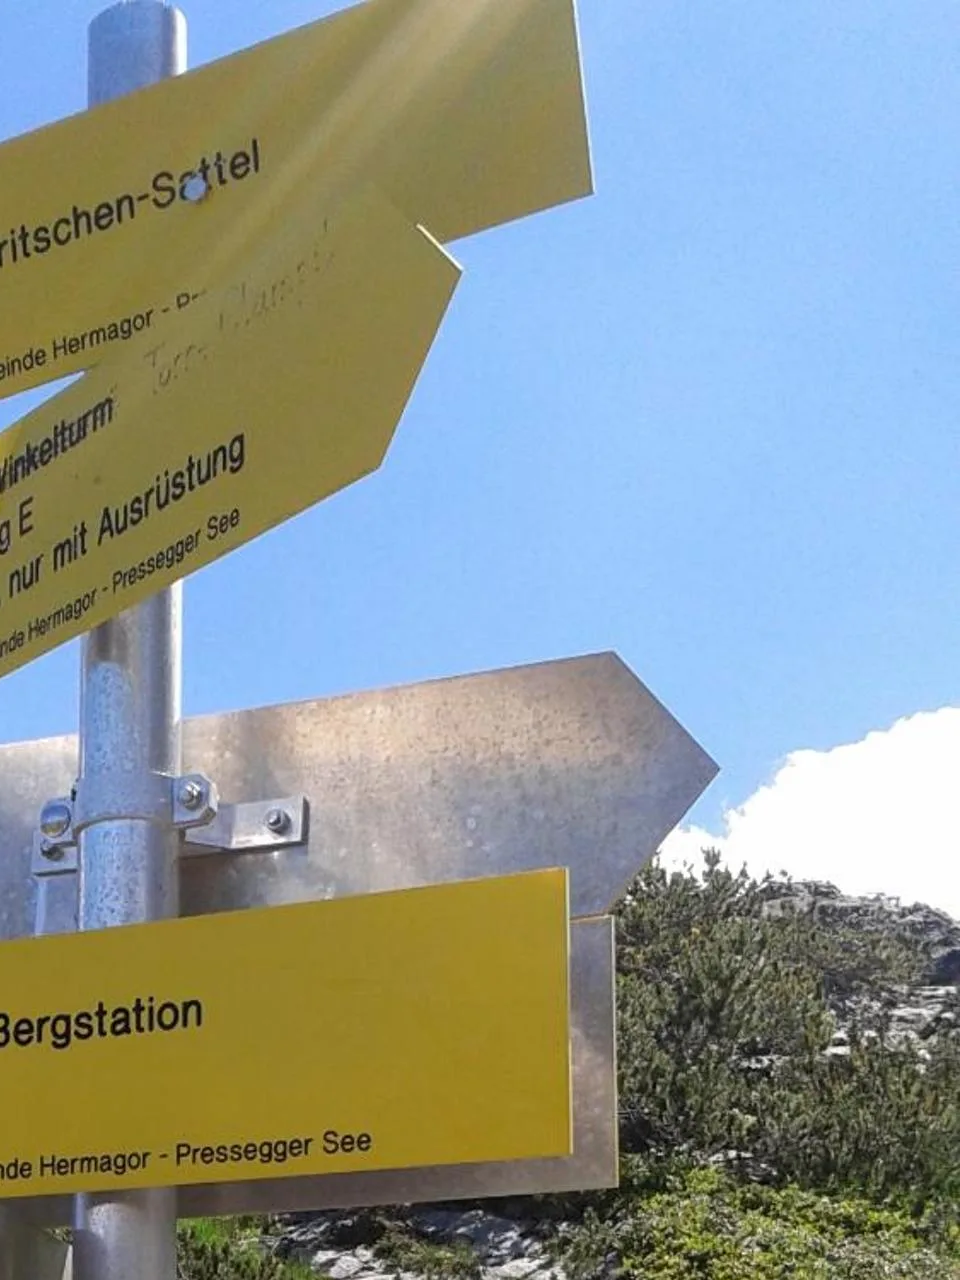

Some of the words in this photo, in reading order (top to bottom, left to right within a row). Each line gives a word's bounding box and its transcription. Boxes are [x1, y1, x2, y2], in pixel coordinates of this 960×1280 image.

[52, 307, 154, 360] Hermagor
[8, 554, 43, 599] nur
[52, 523, 88, 573] mit
[97, 431, 246, 541] Ausrüstung
[19, 497, 34, 537] E
[28, 590, 98, 641] Hermagor
[113, 528, 202, 595] Pressegger
[206, 506, 241, 538] See
[40, 1149, 151, 1179] Hermagor
[176, 1133, 314, 1167] Pressegger
[321, 1130, 372, 1154] See
